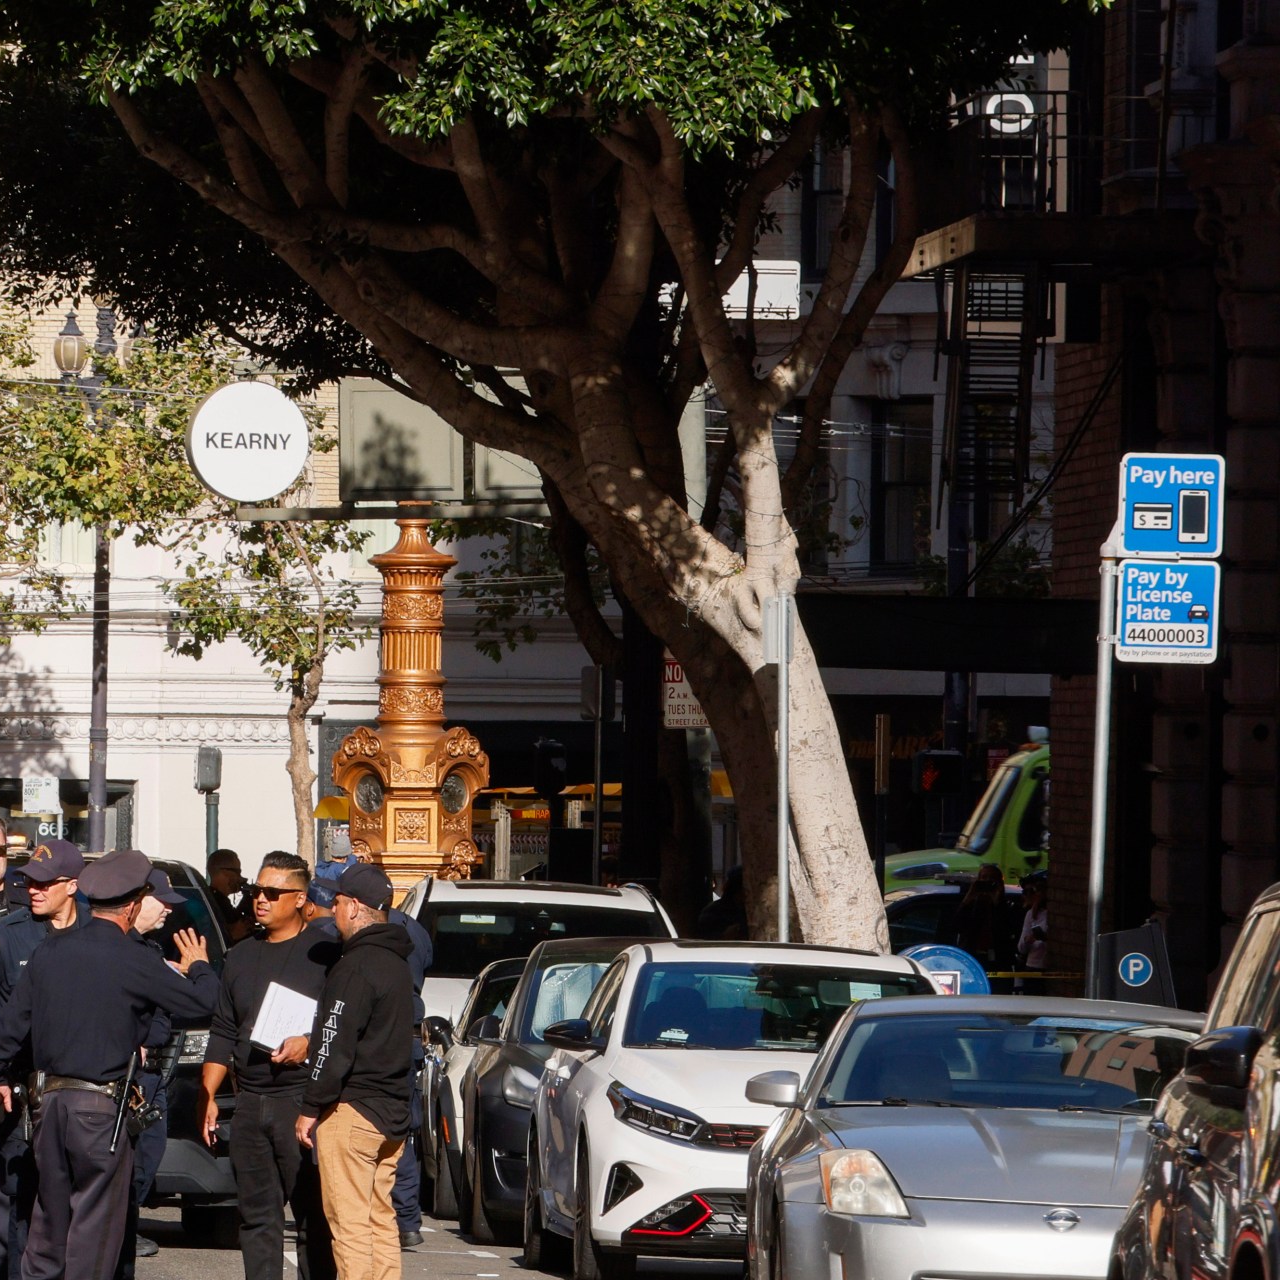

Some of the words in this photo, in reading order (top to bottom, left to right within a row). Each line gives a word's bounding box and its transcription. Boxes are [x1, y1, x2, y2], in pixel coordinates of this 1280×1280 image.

[206, 432, 291, 450] KEARNY
[1130, 465, 1167, 488] Pay
[1170, 465, 1215, 485] here
[1128, 568, 1160, 588] Pay
[1165, 568, 1188, 589] by
[1127, 585, 1193, 603] License
[1126, 603, 1171, 621] Plate
[1127, 628, 1205, 643] 44000003
[665, 664, 682, 681] NO
[668, 687, 675, 699] 2
[668, 704, 686, 715] TUES
[535, 810, 550, 819] RAP
[1129, 959, 1144, 980] P
[311, 1000, 345, 1080] HAWAII
